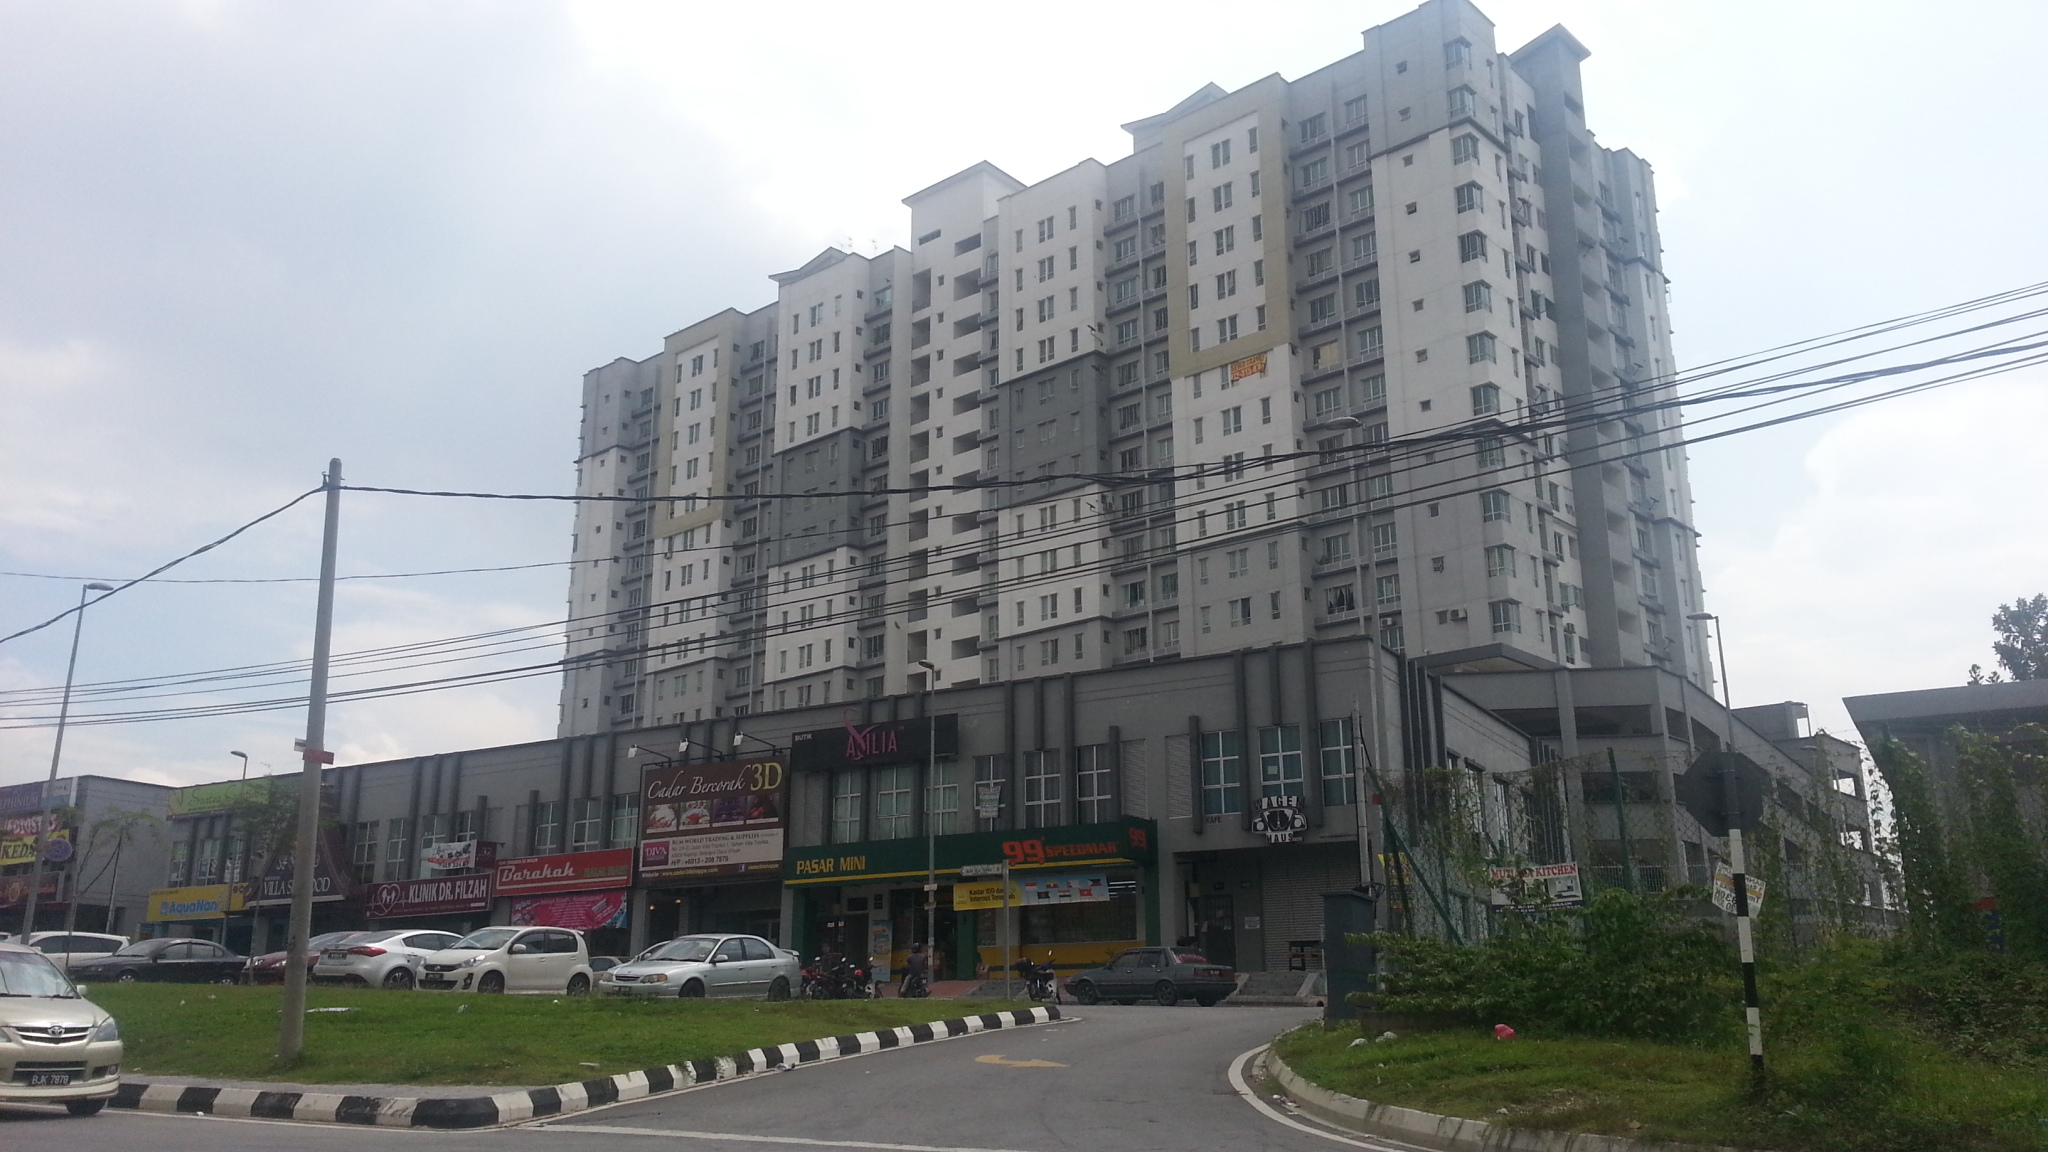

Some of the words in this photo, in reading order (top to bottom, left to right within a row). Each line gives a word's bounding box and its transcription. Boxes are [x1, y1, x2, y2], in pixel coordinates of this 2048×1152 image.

[795, 733, 813, 741] BUTIK
[648, 770, 686, 798] Cadar
[690, 765, 751, 794] Bercorak
[751, 762, 783, 791] 3D
[1254, 795, 1306, 810] WAGEN
[1129, 828, 1147, 848] 99
[1267, 832, 1293, 843] HAUS
[1002, 839, 1045, 867] 99
[501, 862, 575, 881] Barakah
[796, 858, 834, 874] PASAR
[839, 856, 866, 871] MINI
[1492, 867, 1534, 880] MUTIA
[1536, 864, 1577, 877] KITCHEN
[264, 880, 286, 896] VILLA
[409, 883, 438, 903] KLINIK
[439, 881, 453, 901] DR.
[455, 878, 487, 899] FILZAH
[969, 888, 985, 896] Kadar
[970, 894, 991, 903] Internet
[31, 1074, 47, 1085] BJK
[50, 1074, 69, 1085] 7878
